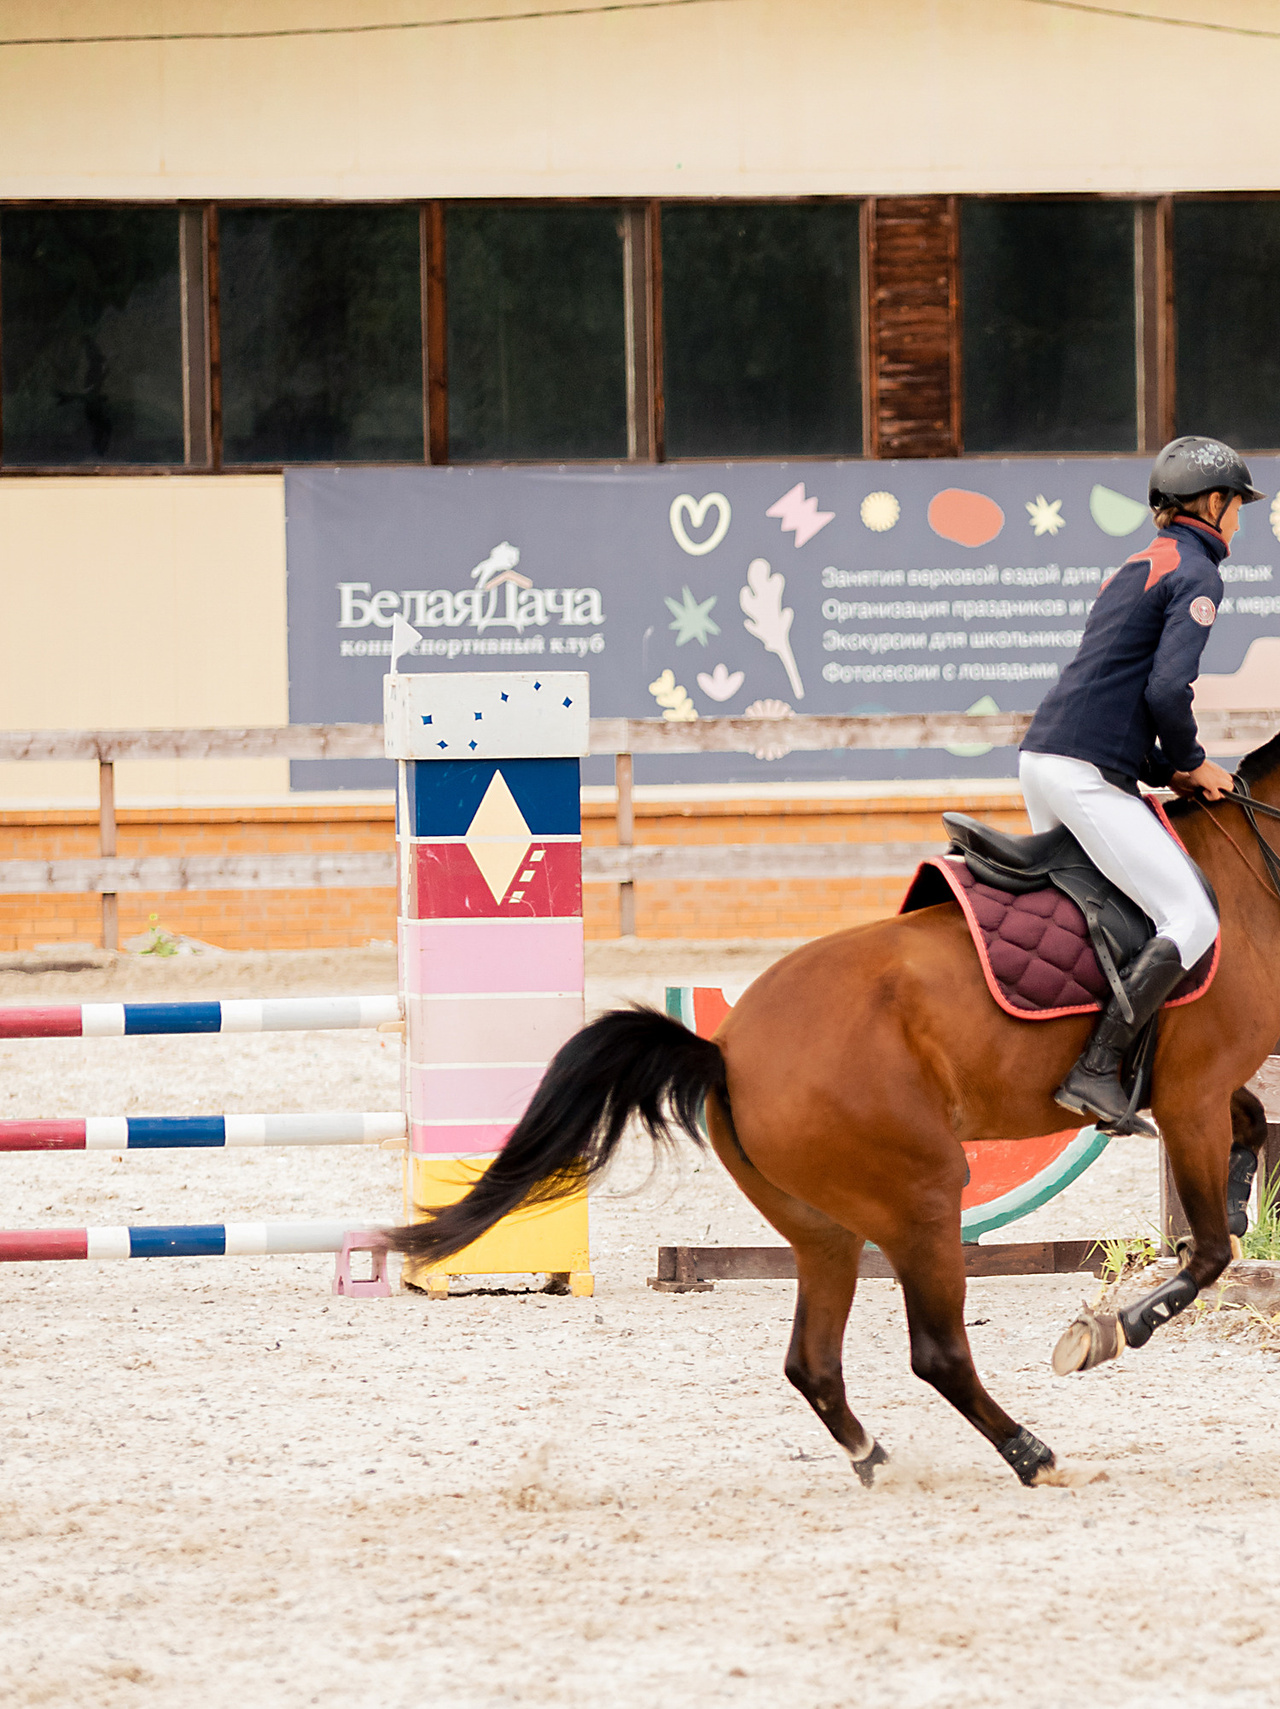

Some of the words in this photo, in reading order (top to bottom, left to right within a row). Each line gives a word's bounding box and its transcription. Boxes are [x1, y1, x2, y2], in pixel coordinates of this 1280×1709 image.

[822, 566, 905, 588] Занятия
[907, 564, 999, 589] верховой
[1001, 563, 1060, 587] ездой
[1062, 567, 1101, 586] для
[822, 598, 950, 623] Организация
[951, 598, 1067, 621] праздников
[1068, 599, 1085, 616] и
[340, 634, 546, 659] коннспортивный
[550, 632, 606, 658] клуб
[822, 629, 928, 654] Экскурсии
[929, 631, 968, 651] для
[822, 661, 941, 684] Фотосессии
[942, 663, 957, 682] с
[958, 662, 1059, 682] лошадьми
